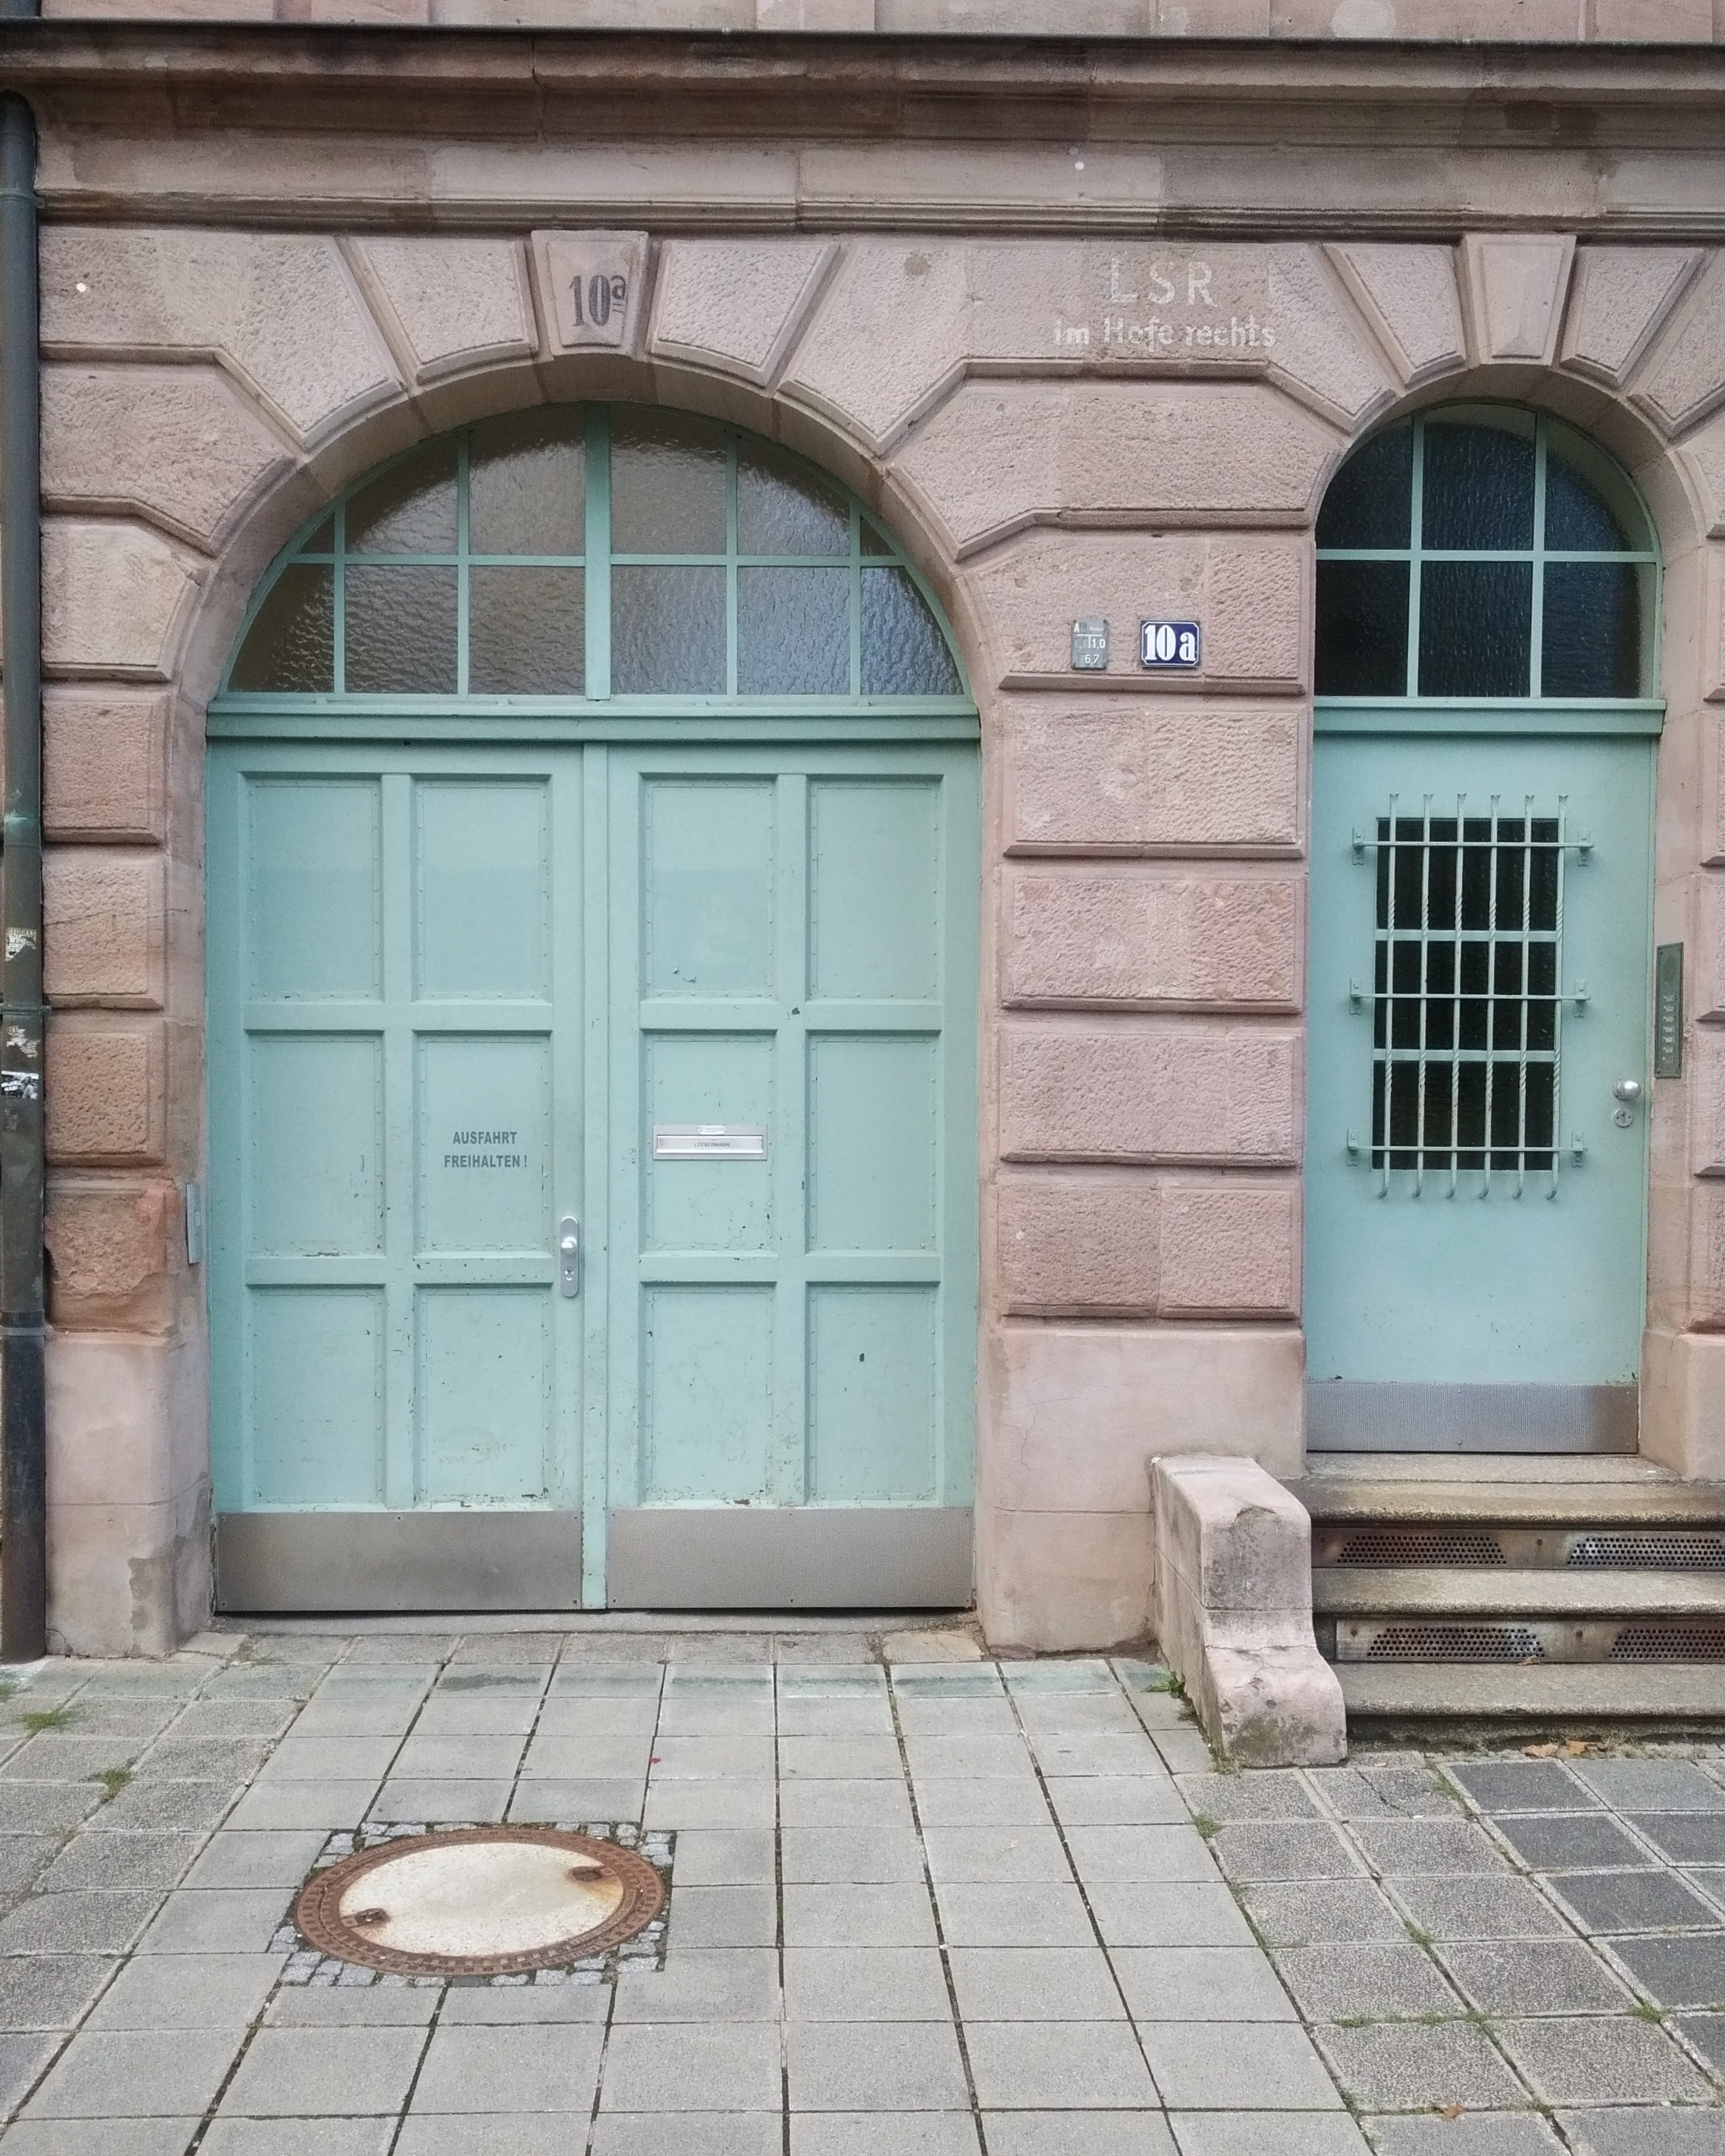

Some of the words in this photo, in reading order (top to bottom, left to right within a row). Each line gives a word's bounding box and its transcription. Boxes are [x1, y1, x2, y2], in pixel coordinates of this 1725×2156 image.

[569, 274, 627, 327] 10a
[1109, 257, 1218, 307] LSR
[1053, 317, 1090, 346] im
[1104, 315, 1174, 352] Hofe
[1186, 315, 1277, 348] rechts
[1085, 654, 1100, 666] 6,7
[1144, 624, 1196, 661] 10a
[453, 1131, 517, 1144] AUSFAHRT
